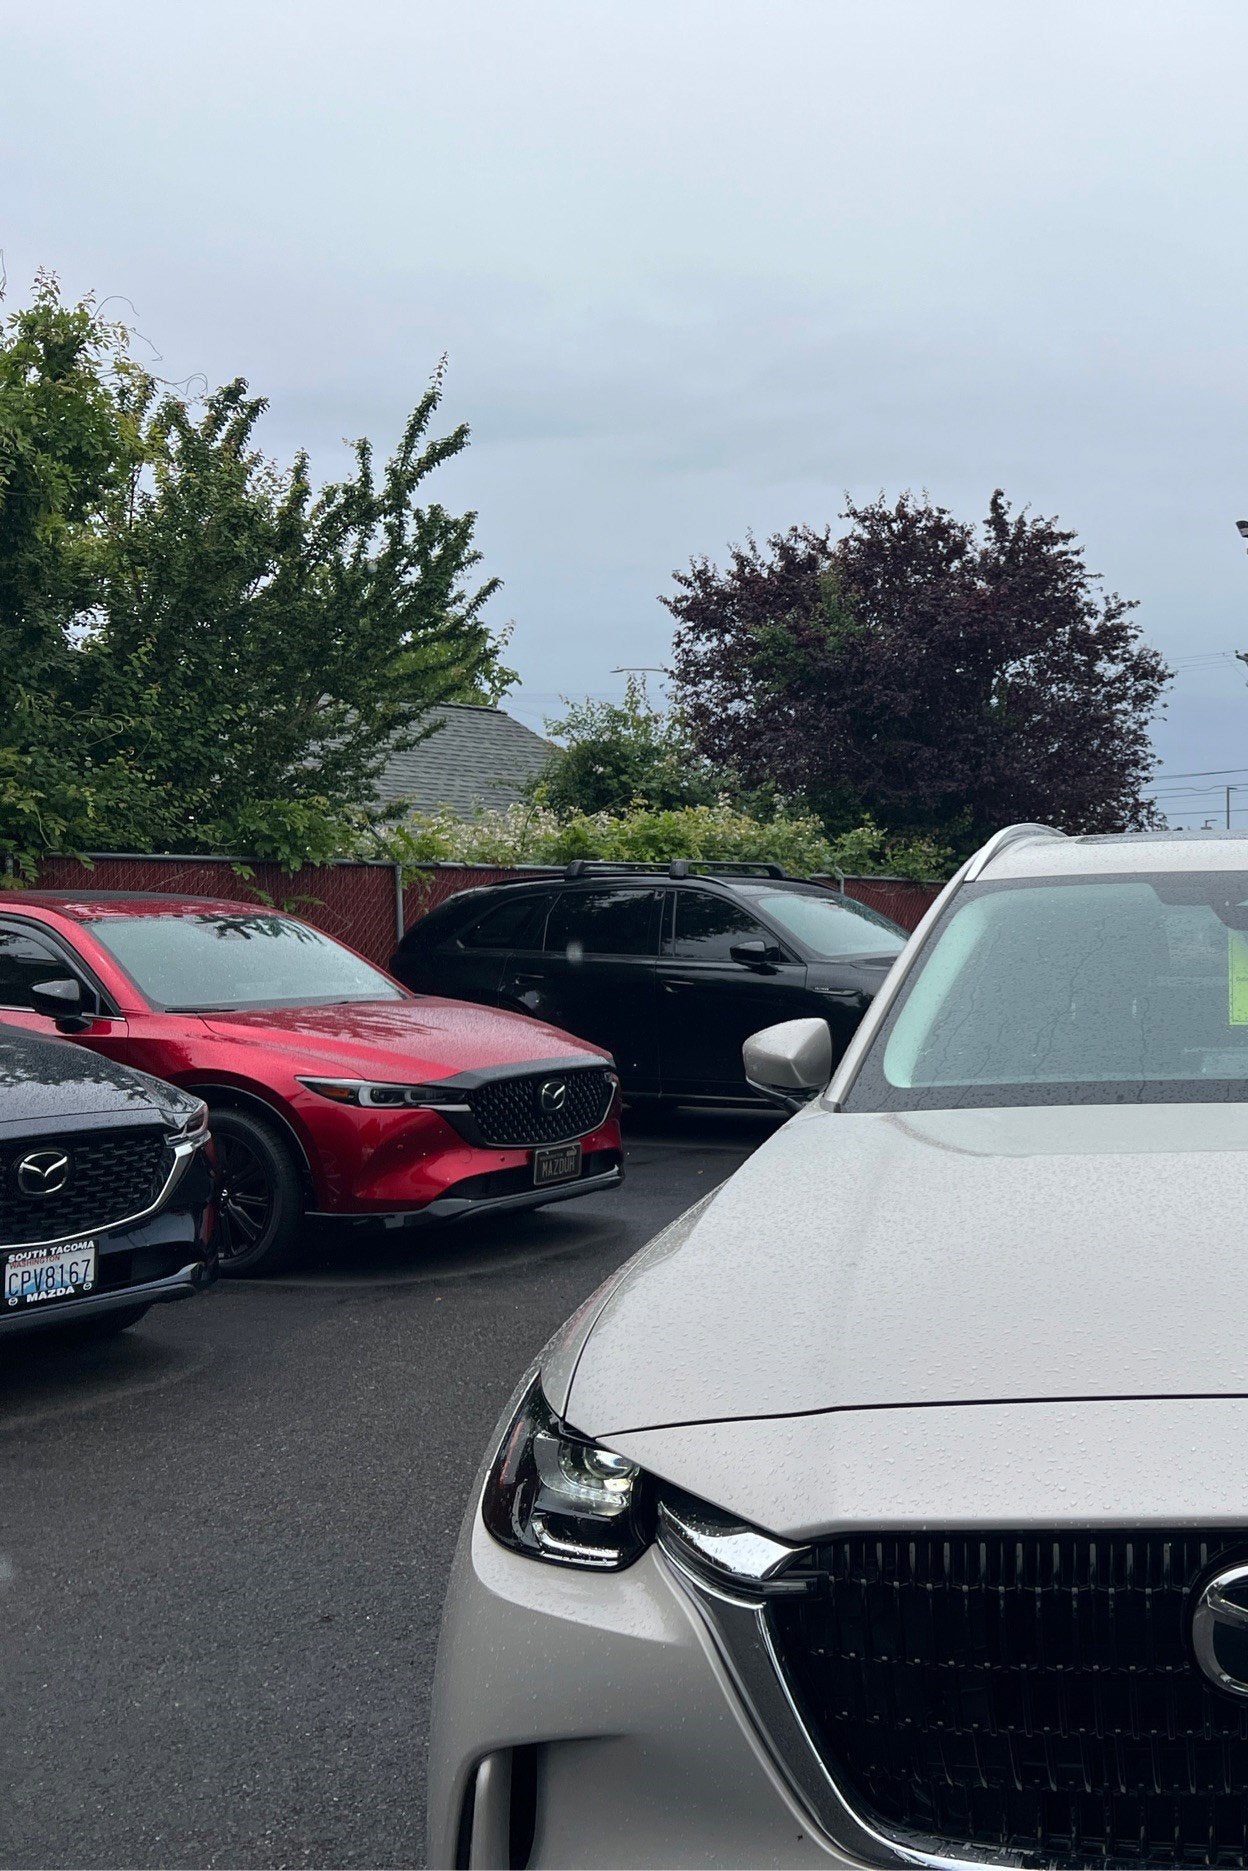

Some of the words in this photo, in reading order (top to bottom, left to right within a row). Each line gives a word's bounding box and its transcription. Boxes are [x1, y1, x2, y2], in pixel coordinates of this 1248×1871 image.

[8, 1249, 47, 1263] SOUTH
[50, 1240, 95, 1255] TACOMA
[10, 1254, 61, 1269] WASHINGTON
[9, 1259, 91, 1296] CPV8167
[26, 1286, 75, 1302] MAZDA
